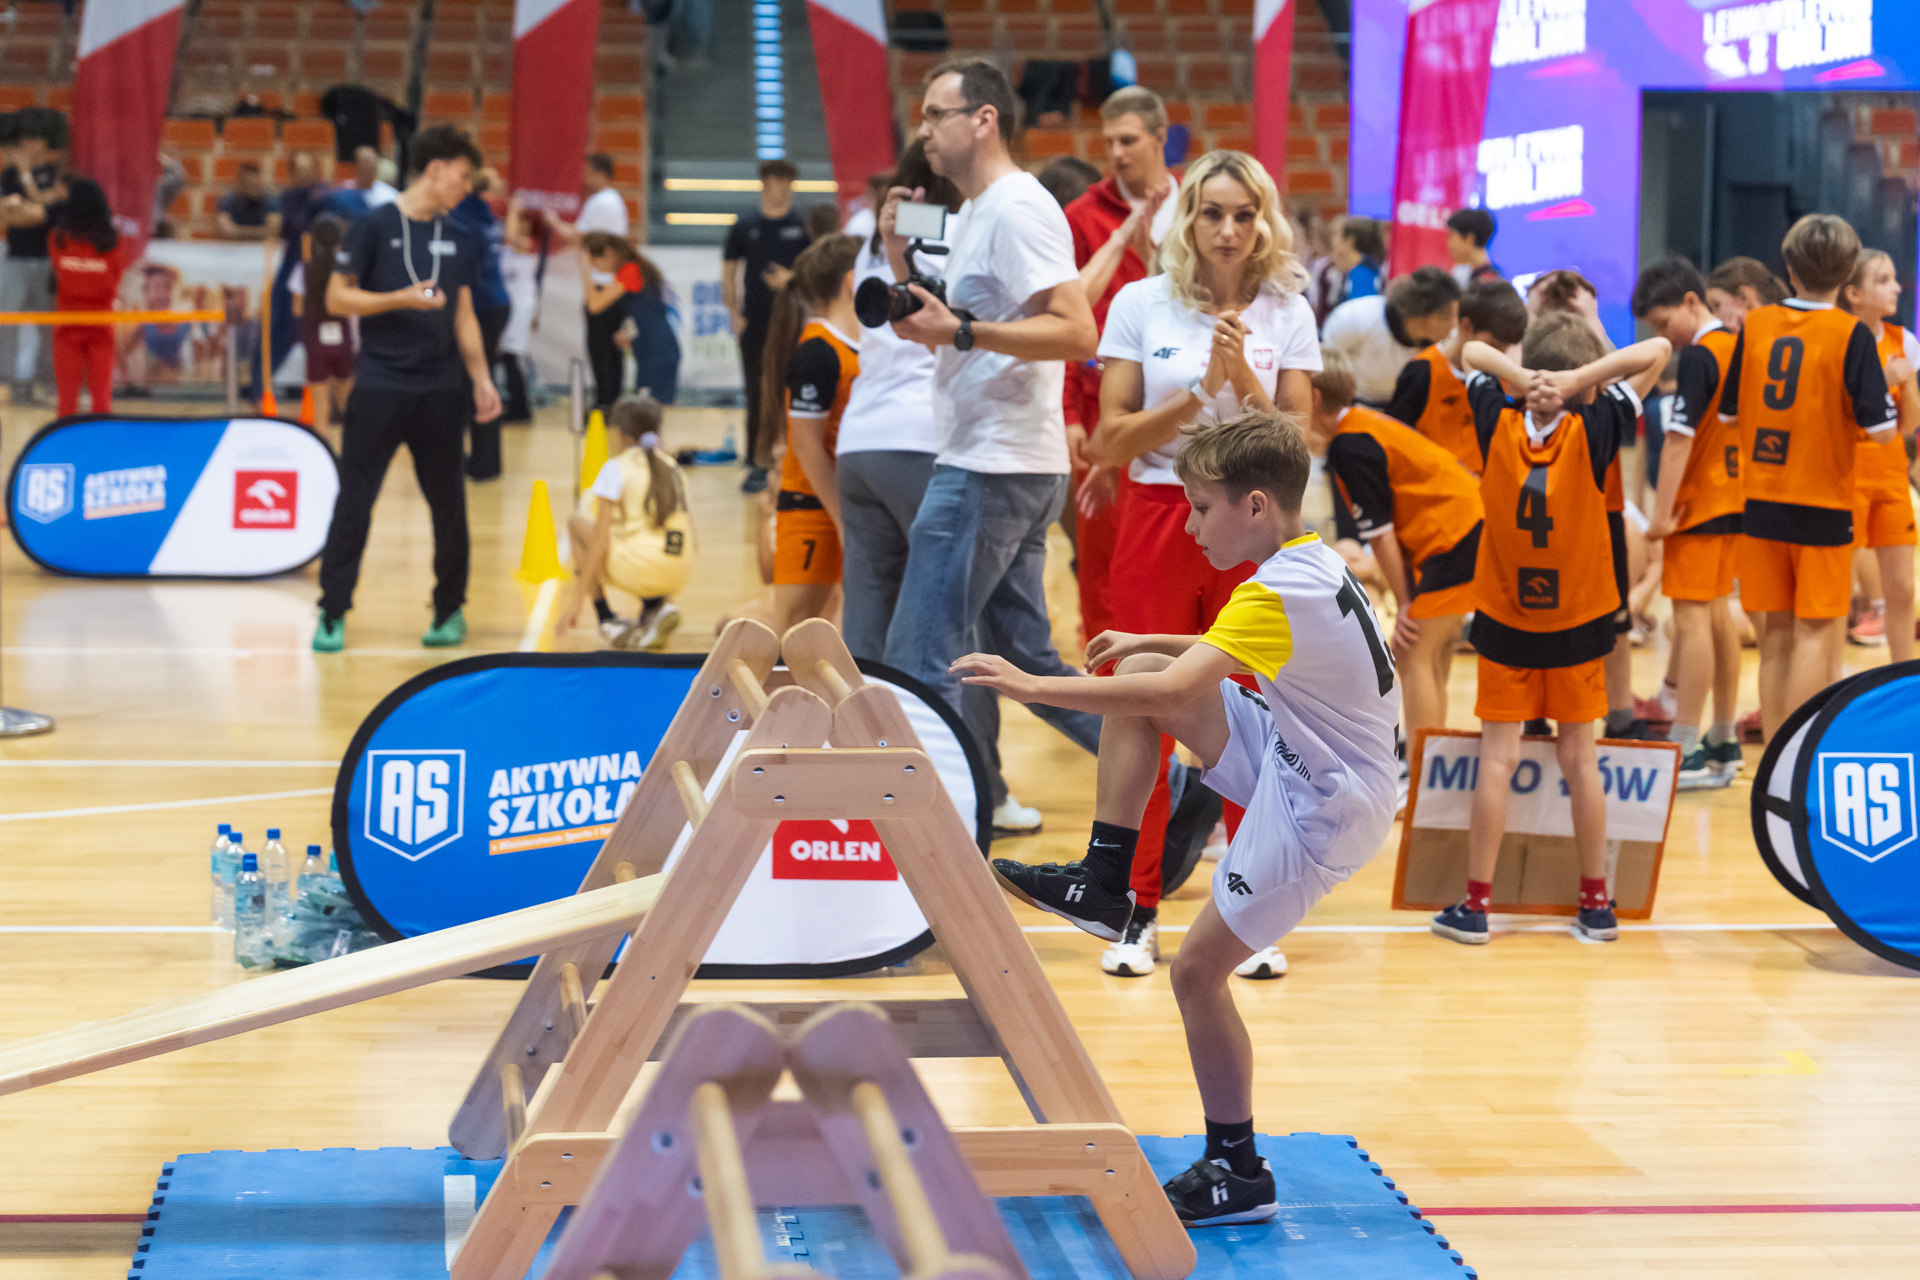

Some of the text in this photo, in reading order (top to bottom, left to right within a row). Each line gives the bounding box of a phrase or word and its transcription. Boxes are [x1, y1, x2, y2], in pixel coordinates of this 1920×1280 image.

[1763, 336, 1804, 410] 9
[1516, 465, 1553, 548] 4
[803, 539, 816, 571] 7
[380, 760, 450, 846] AS
[488, 751, 642, 798] AKTYWNA
[1833, 762, 1902, 847] AS
[789, 839, 881, 862] ORLEN
[1227, 871, 1254, 896] 4F
